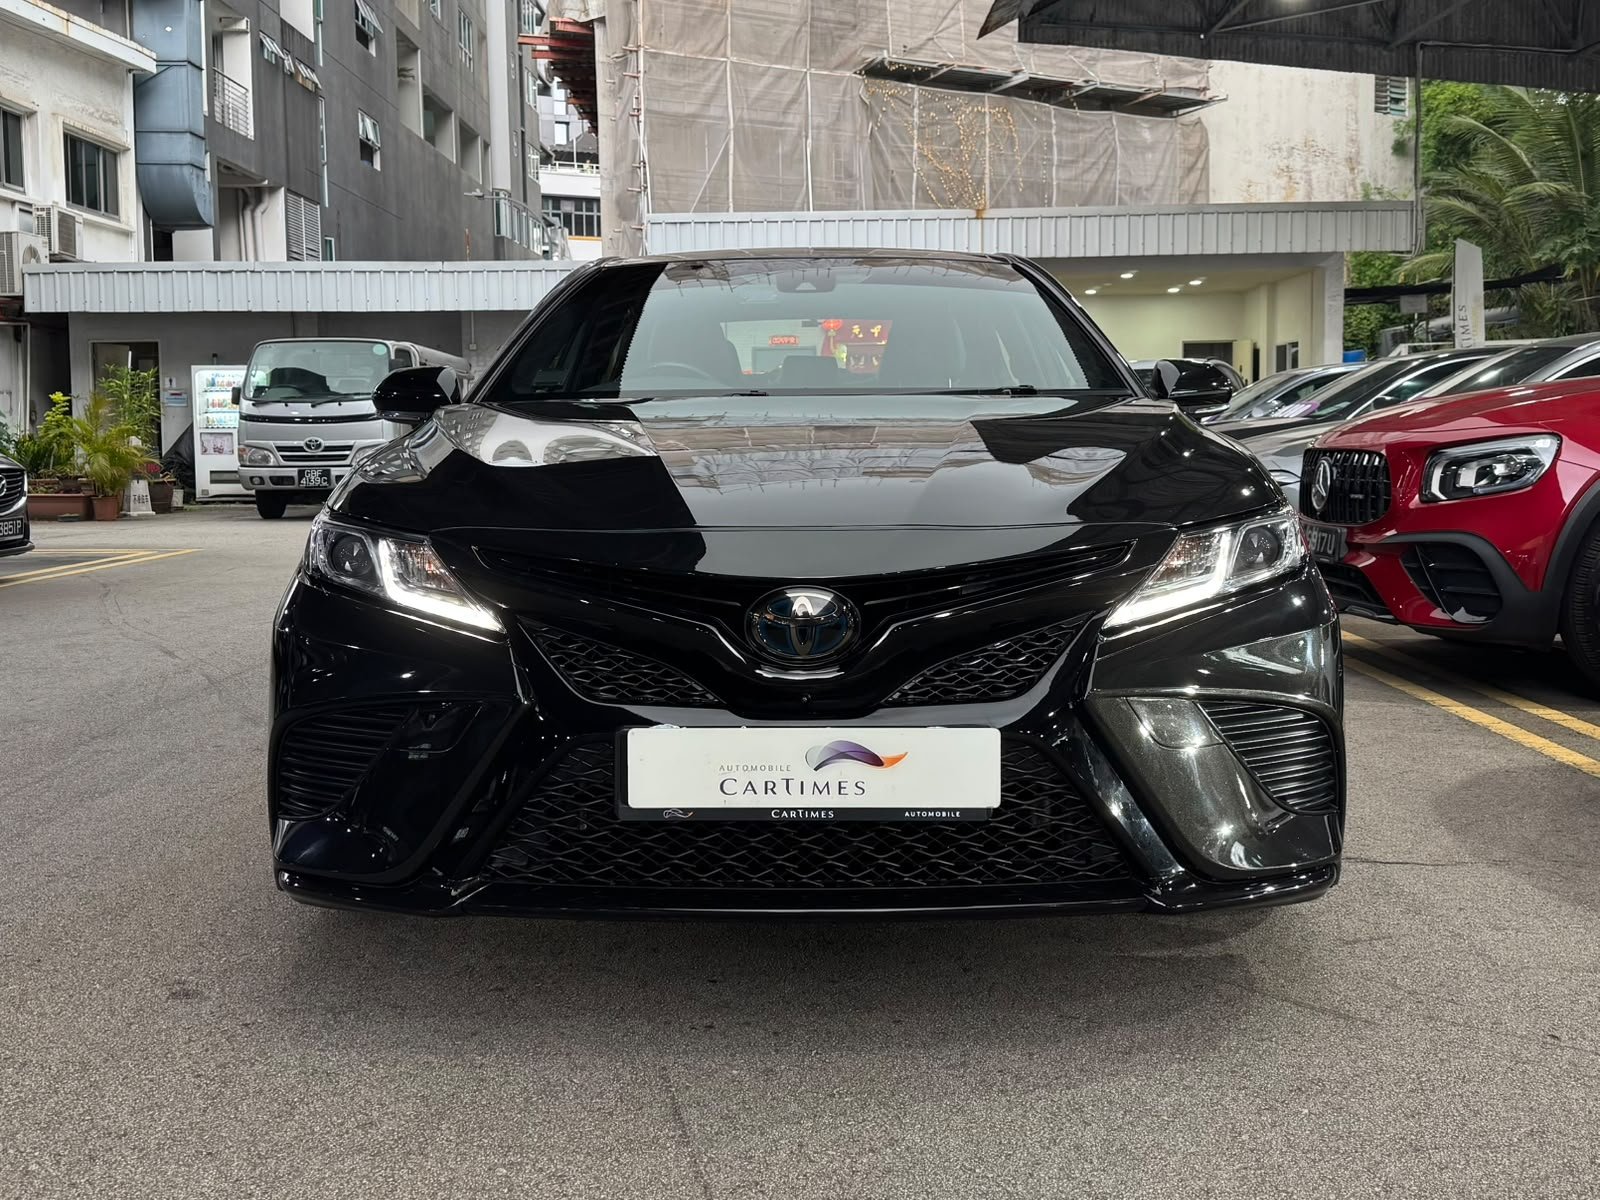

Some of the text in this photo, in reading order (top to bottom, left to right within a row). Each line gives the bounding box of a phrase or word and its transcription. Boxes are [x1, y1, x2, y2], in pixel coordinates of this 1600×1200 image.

[304, 469, 323, 478] GBF
[300, 476, 328, 486] 4139C
[719, 764, 792, 772] AUTOMOBILE
[904, 810, 961, 818] AUTOMOBILE
